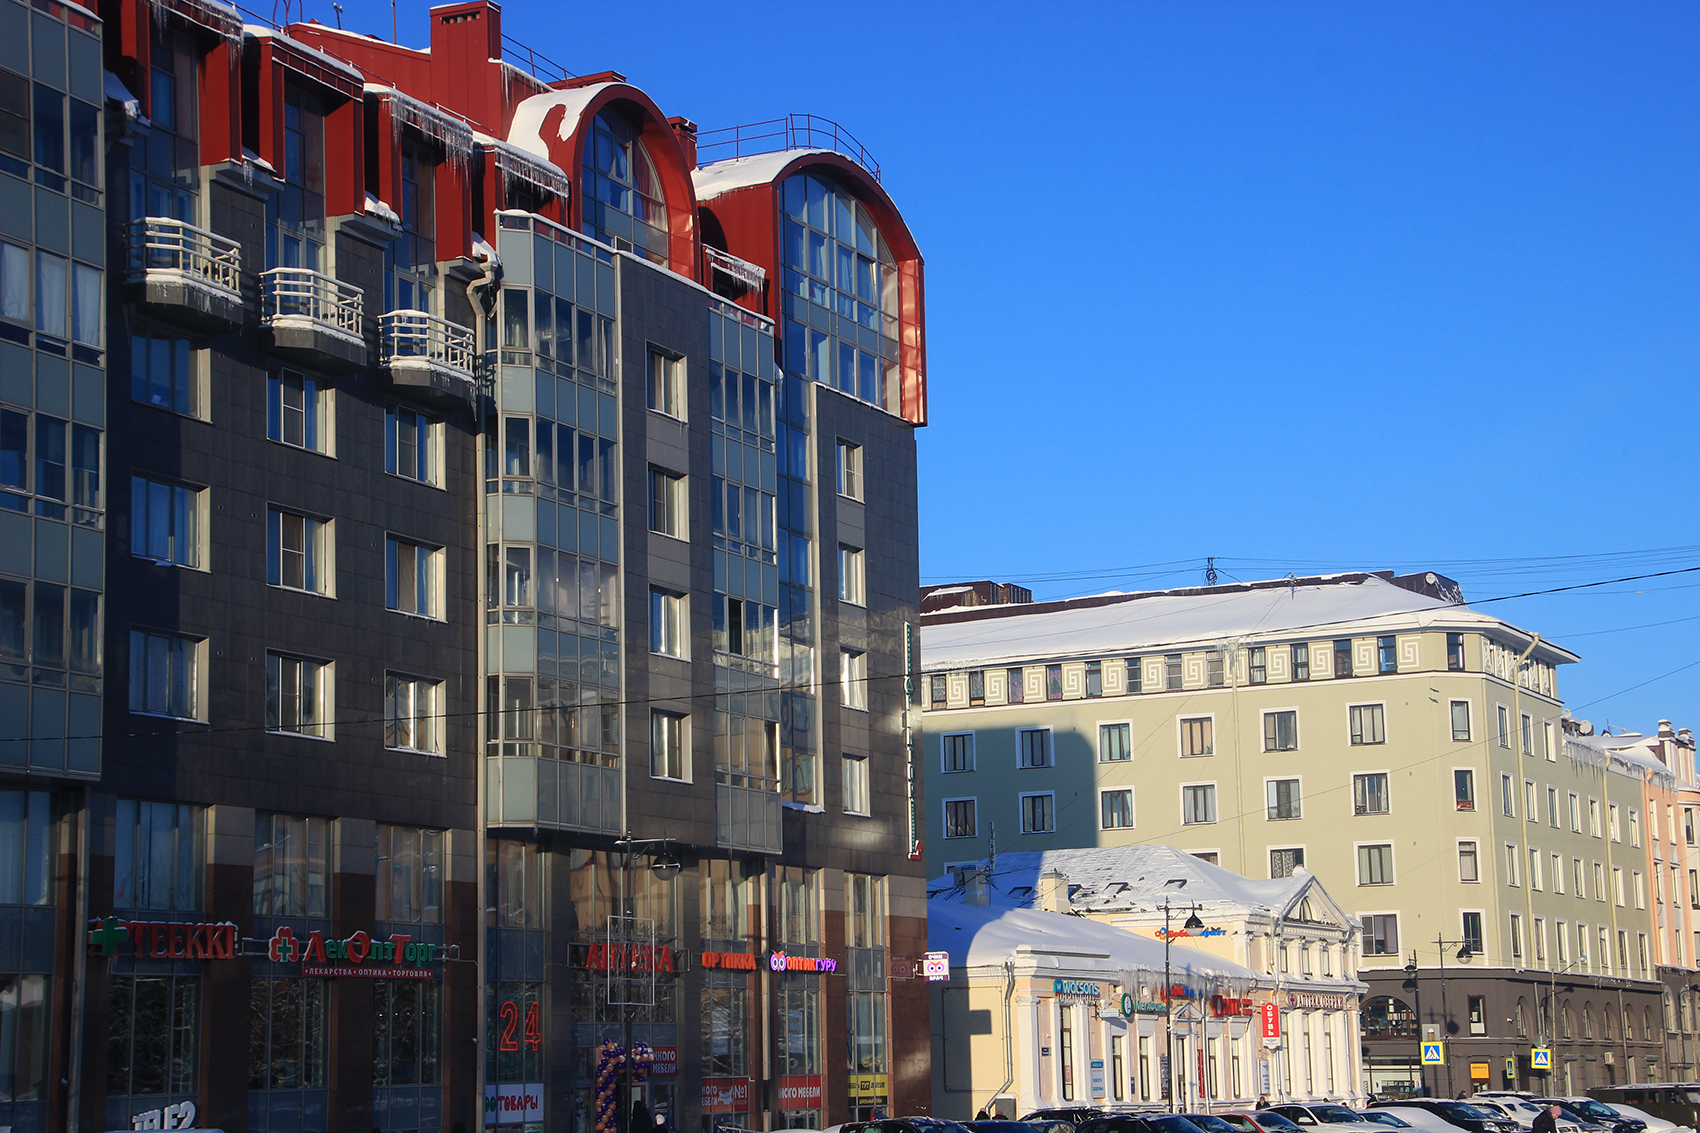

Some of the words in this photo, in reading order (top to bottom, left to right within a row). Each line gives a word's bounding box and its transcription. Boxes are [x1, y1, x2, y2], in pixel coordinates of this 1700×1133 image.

[392, 969, 428, 977] ТОРГОВЛЯ
[500, 1001, 540, 1051] 24
[1266, 1004, 1275, 1036] ОБУВЬ
[702, 1085, 718, 1095] НОГО
[485, 1095, 538, 1112] ООТОВАРЫ
